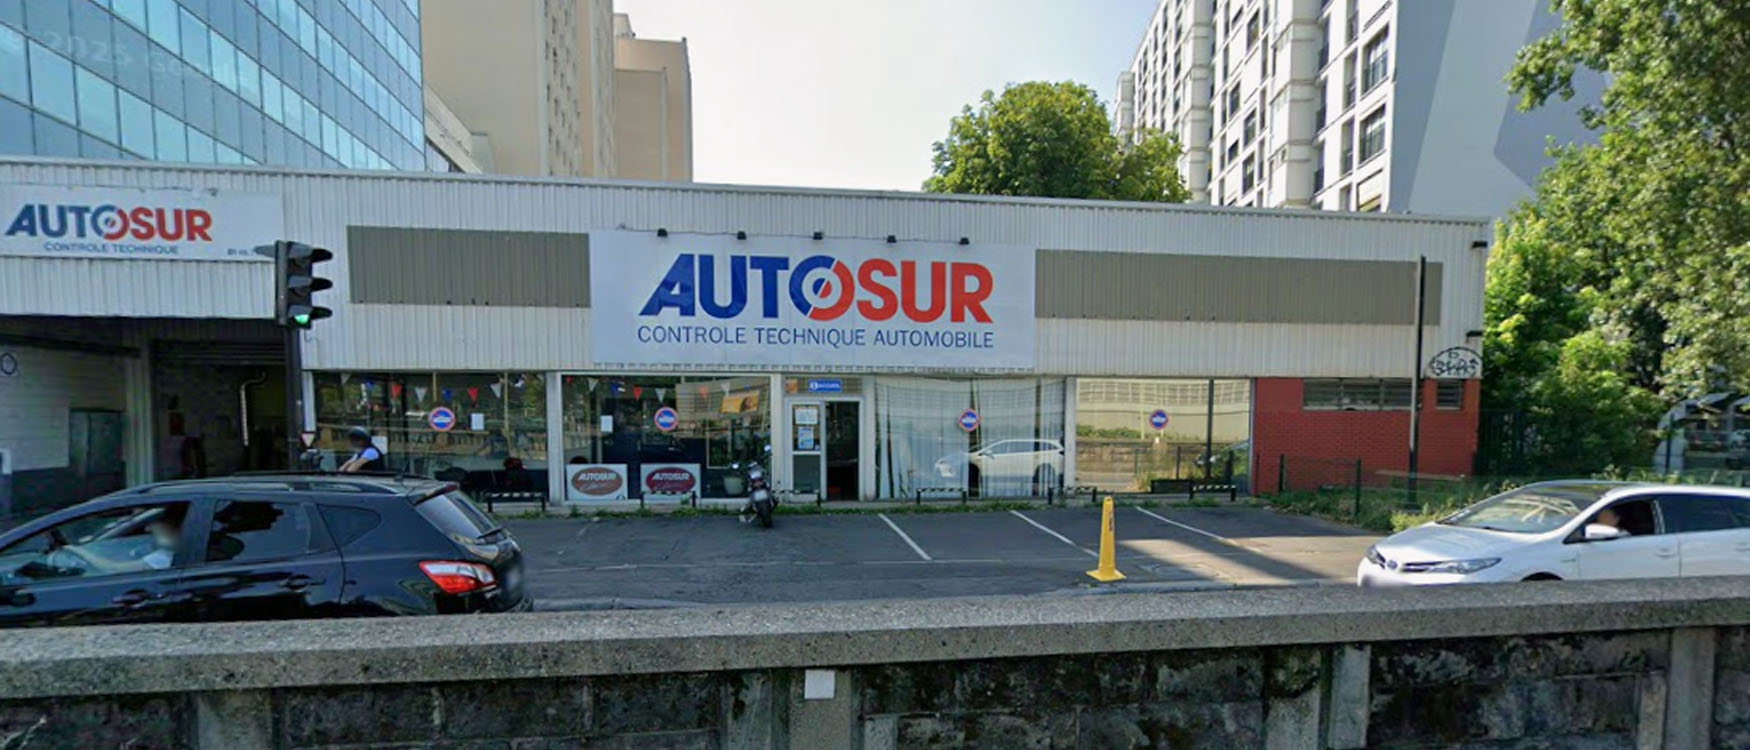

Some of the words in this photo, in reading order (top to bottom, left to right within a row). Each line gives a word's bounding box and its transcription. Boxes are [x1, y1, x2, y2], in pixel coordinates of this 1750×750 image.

[5, 204, 213, 242] AUTOSUR
[44, 242, 105, 253] CONTROLE
[111, 243, 179, 254] TECHNIQUE
[638, 253, 994, 324] AUTOSUR
[637, 325, 747, 344] CONTROLE
[754, 326, 866, 347] TECHNIQUE
[873, 328, 994, 348] AUTOMOBILE
